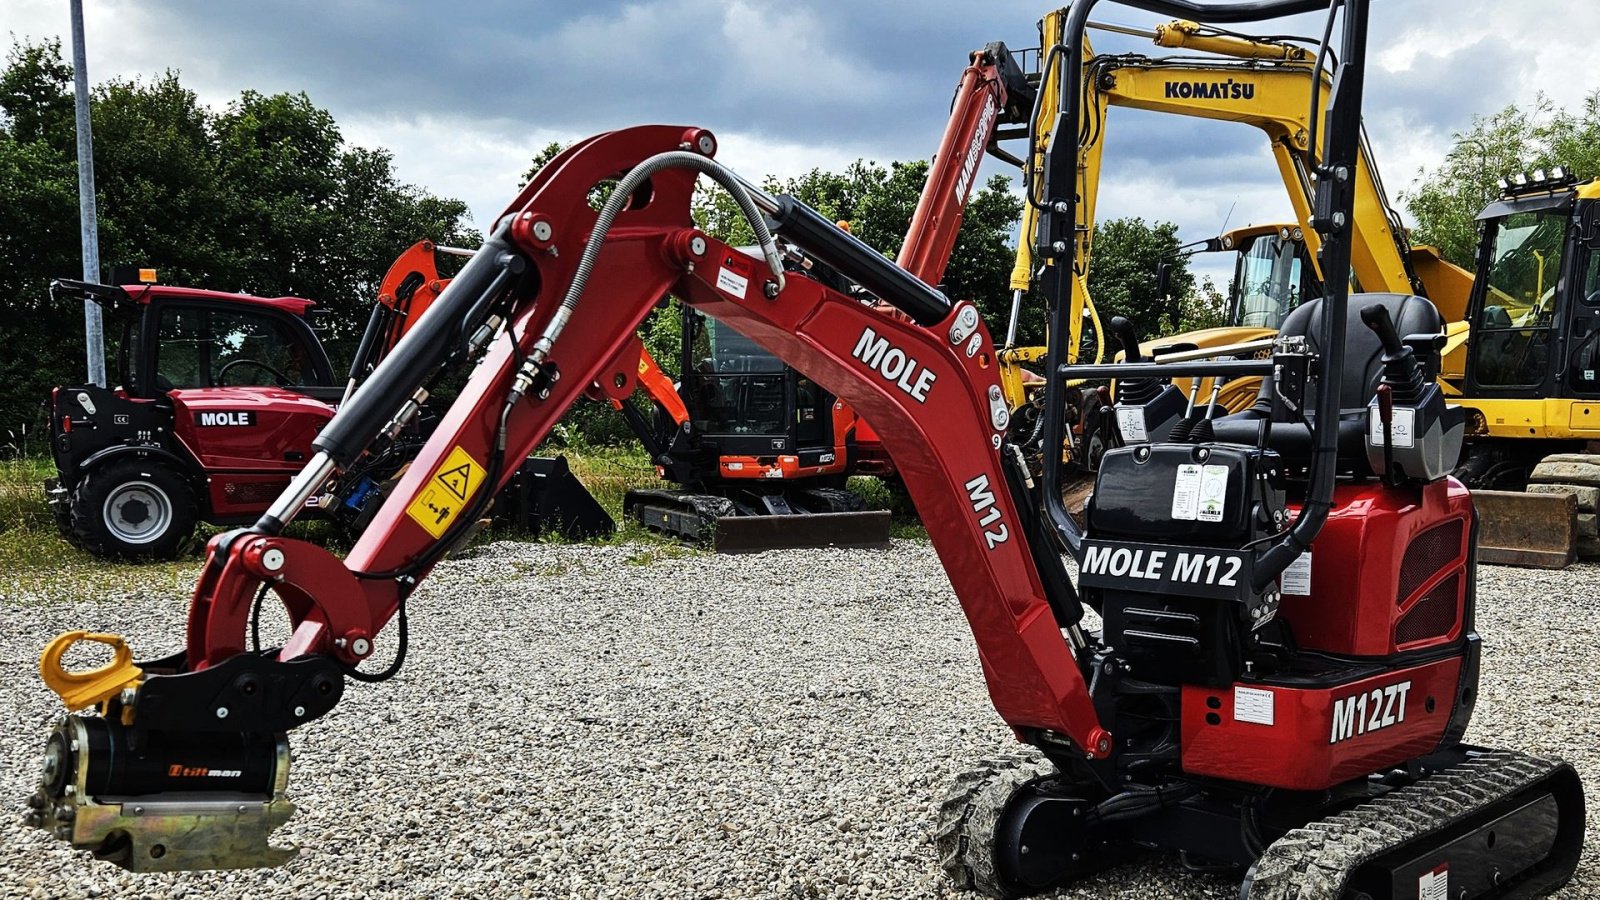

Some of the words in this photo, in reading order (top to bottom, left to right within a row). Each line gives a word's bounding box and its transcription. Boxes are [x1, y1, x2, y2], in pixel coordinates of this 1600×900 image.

[1165, 79, 1254, 99] KOMATSU
[955, 94, 994, 206] MANISCOPIC
[852, 326, 937, 403] MOLE
[201, 412, 249, 426] MOLE
[965, 474, 1009, 550] M12
[1081, 546, 1167, 580] MOLE
[1171, 553, 1242, 587] M12
[1330, 680, 1411, 744] M12ZT
